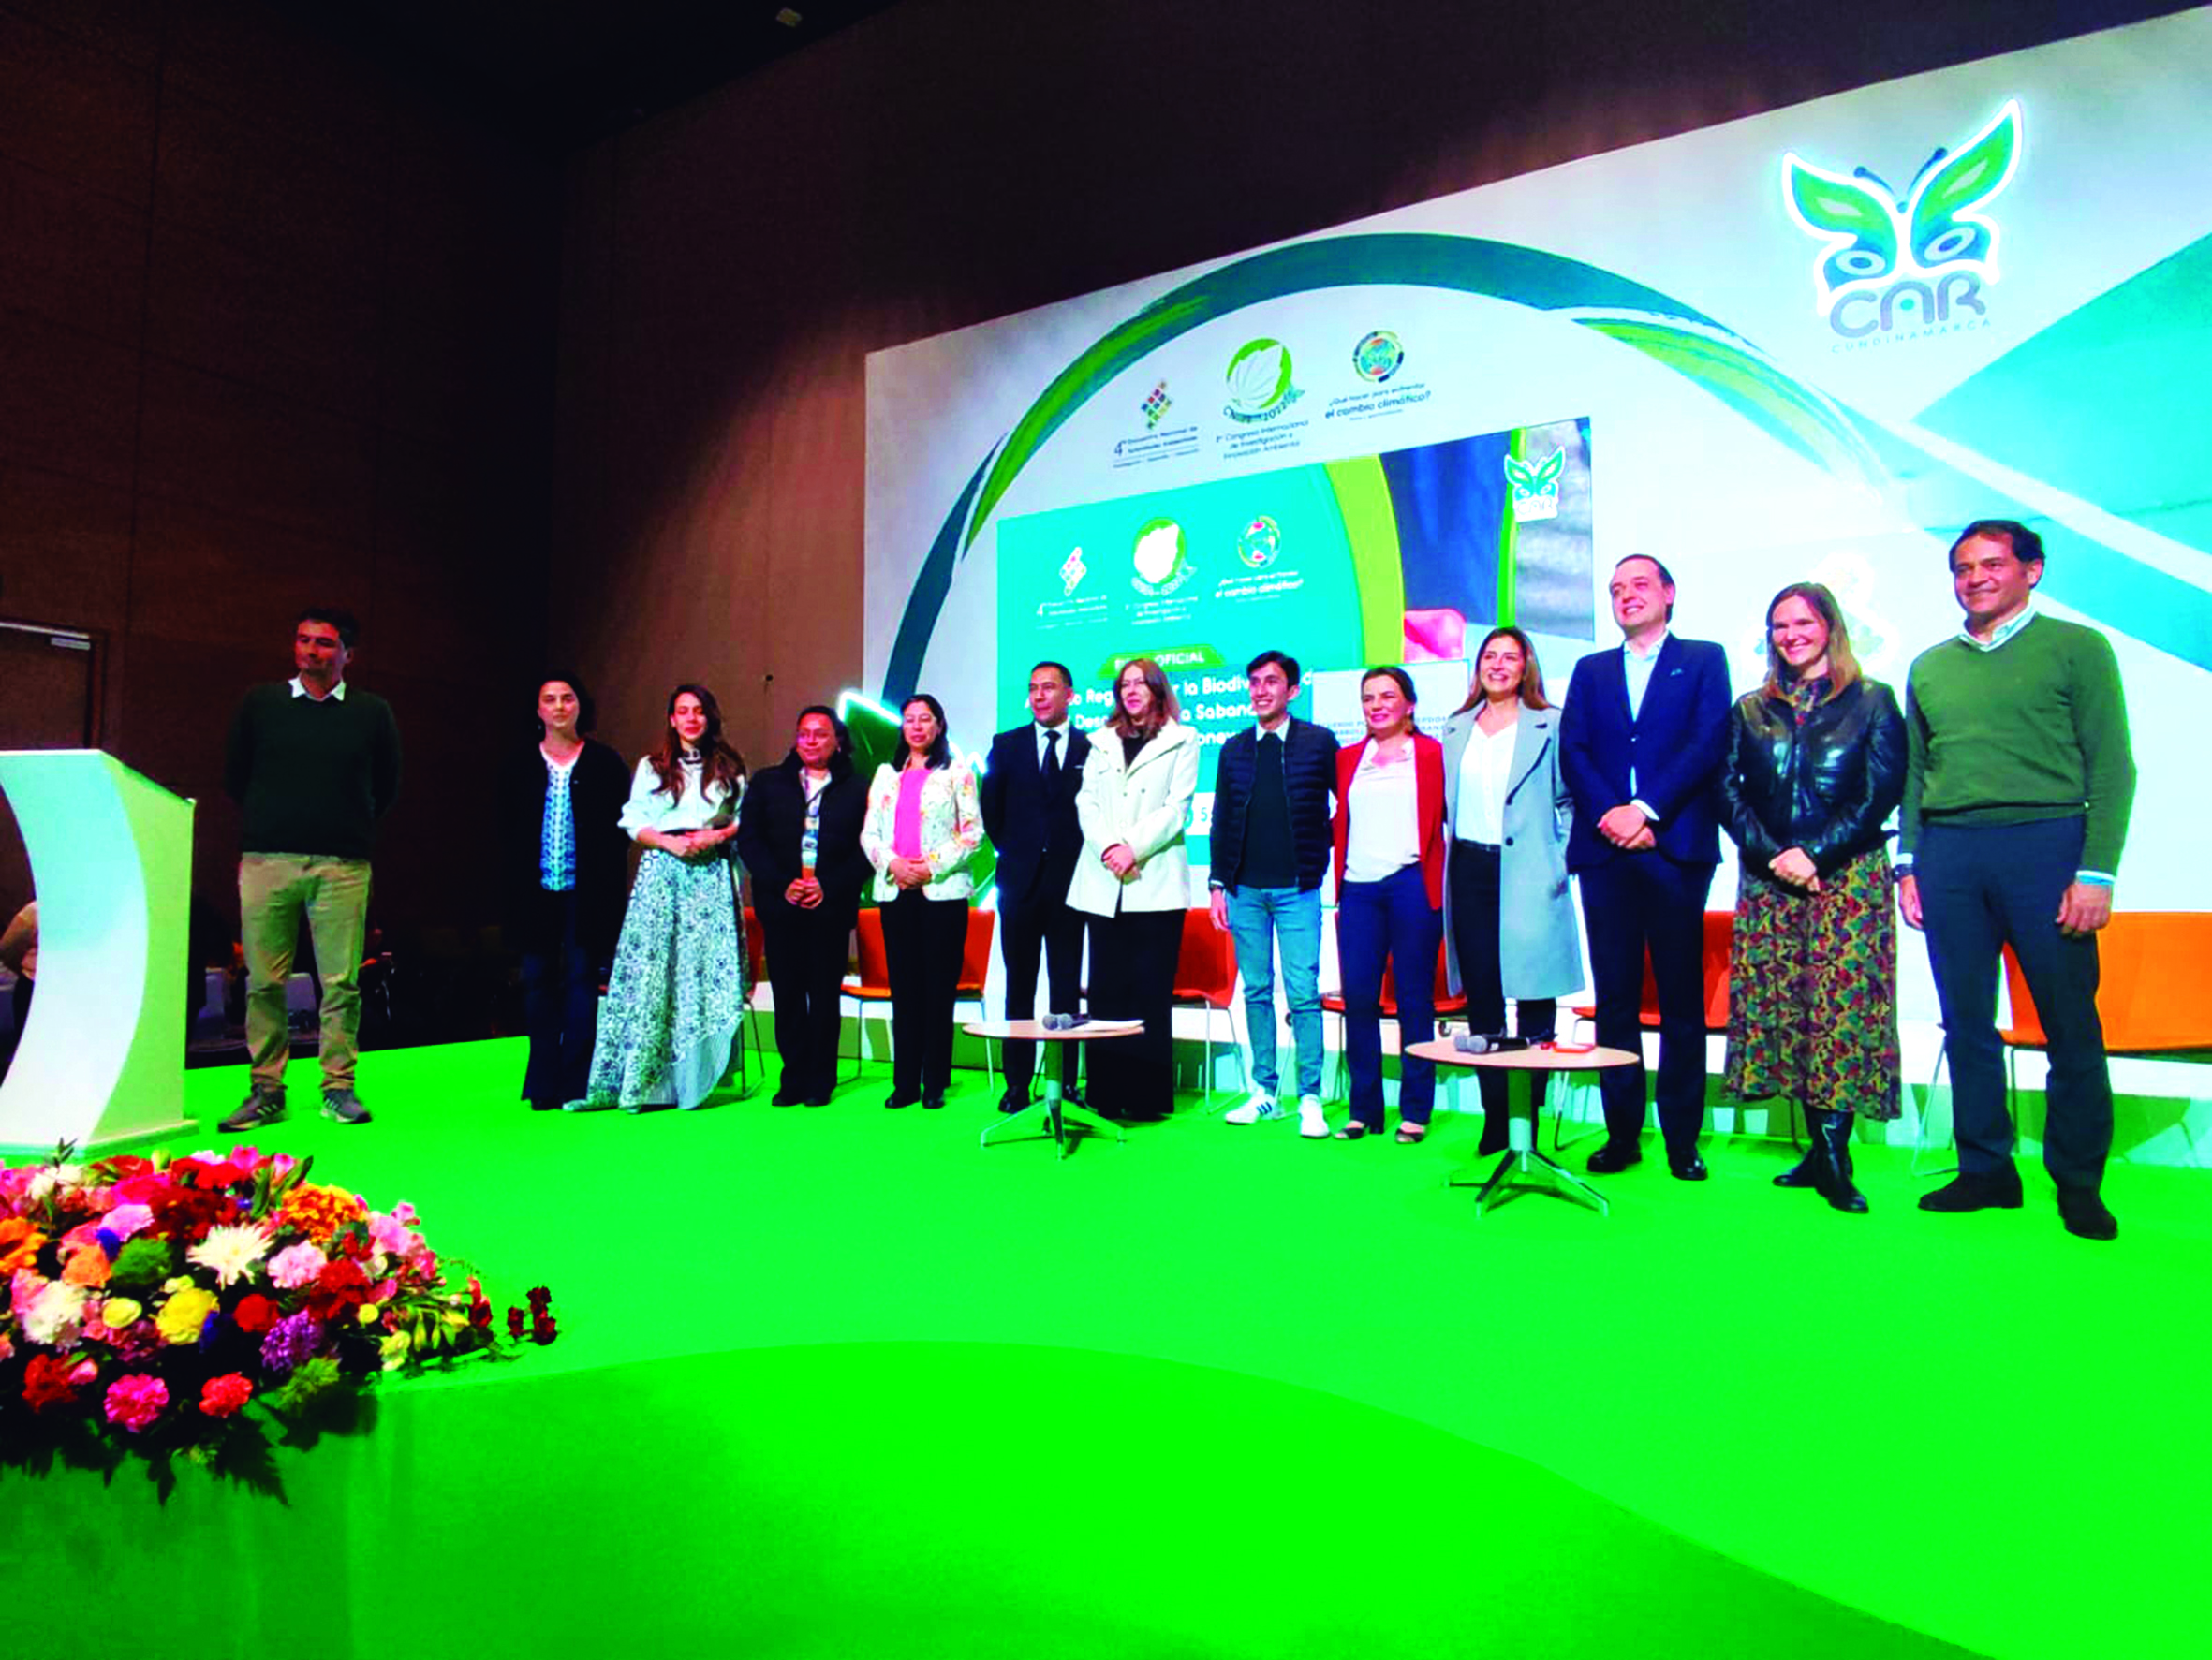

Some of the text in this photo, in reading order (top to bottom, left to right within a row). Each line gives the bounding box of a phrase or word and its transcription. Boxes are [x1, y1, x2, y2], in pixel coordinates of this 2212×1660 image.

[1830, 271, 1986, 338] CAR
[1831, 317, 1991, 354] CUNDINAMARCA
[1155, 652, 1205, 668] OFICIAL
[1184, 680, 1199, 696] la
[1202, 675, 1251, 696] Biodiv
